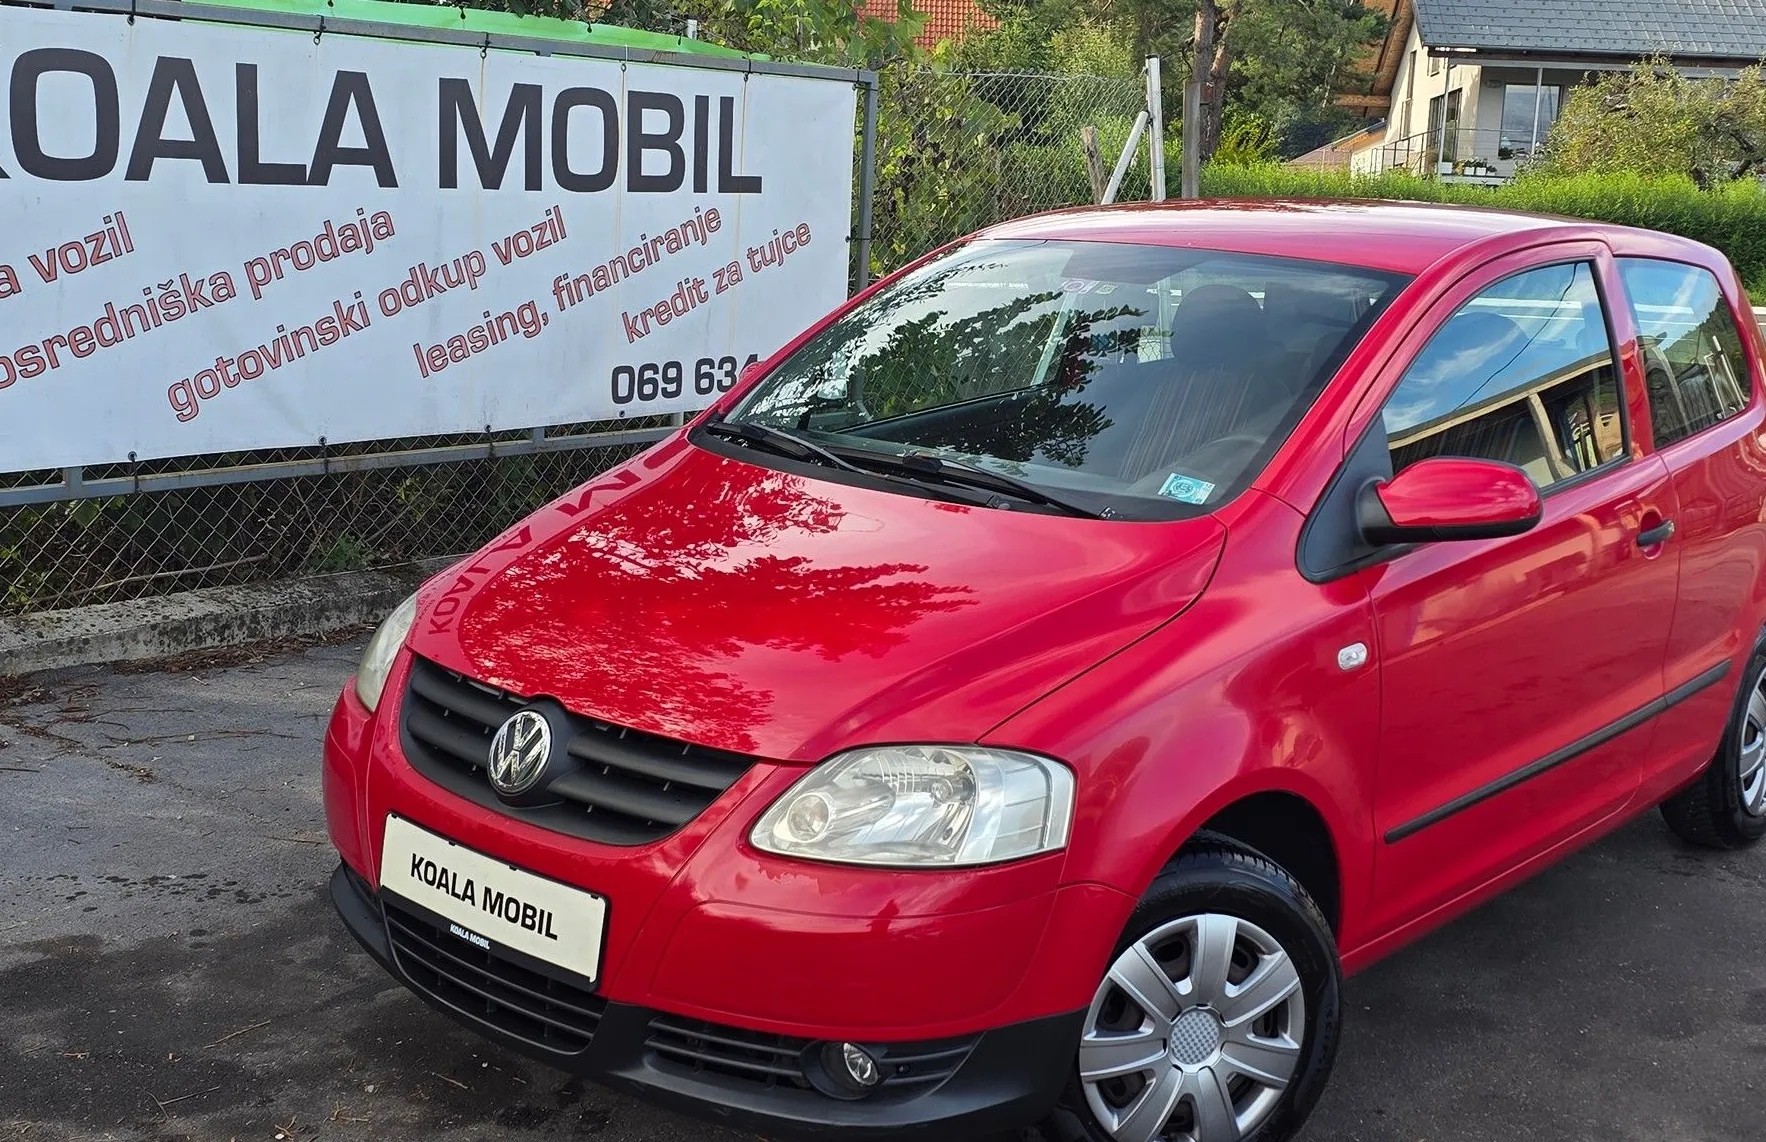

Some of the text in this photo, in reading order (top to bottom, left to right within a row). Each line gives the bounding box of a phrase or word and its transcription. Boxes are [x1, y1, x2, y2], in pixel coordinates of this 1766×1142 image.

[0, 47, 763, 194] OALA MOBIL
[27, 210, 135, 284] vozil
[244, 207, 396, 300] prodaja
[413, 206, 722, 379] leasing, financiranje
[621, 221, 812, 344] kredit za tujce
[167, 205, 567, 423] gotovinski odkup vozil
[611, 360, 683, 405] 069
[410, 852, 558, 941] KOALA MOBIL
[450, 923, 491, 950] KOALA MOBIL
